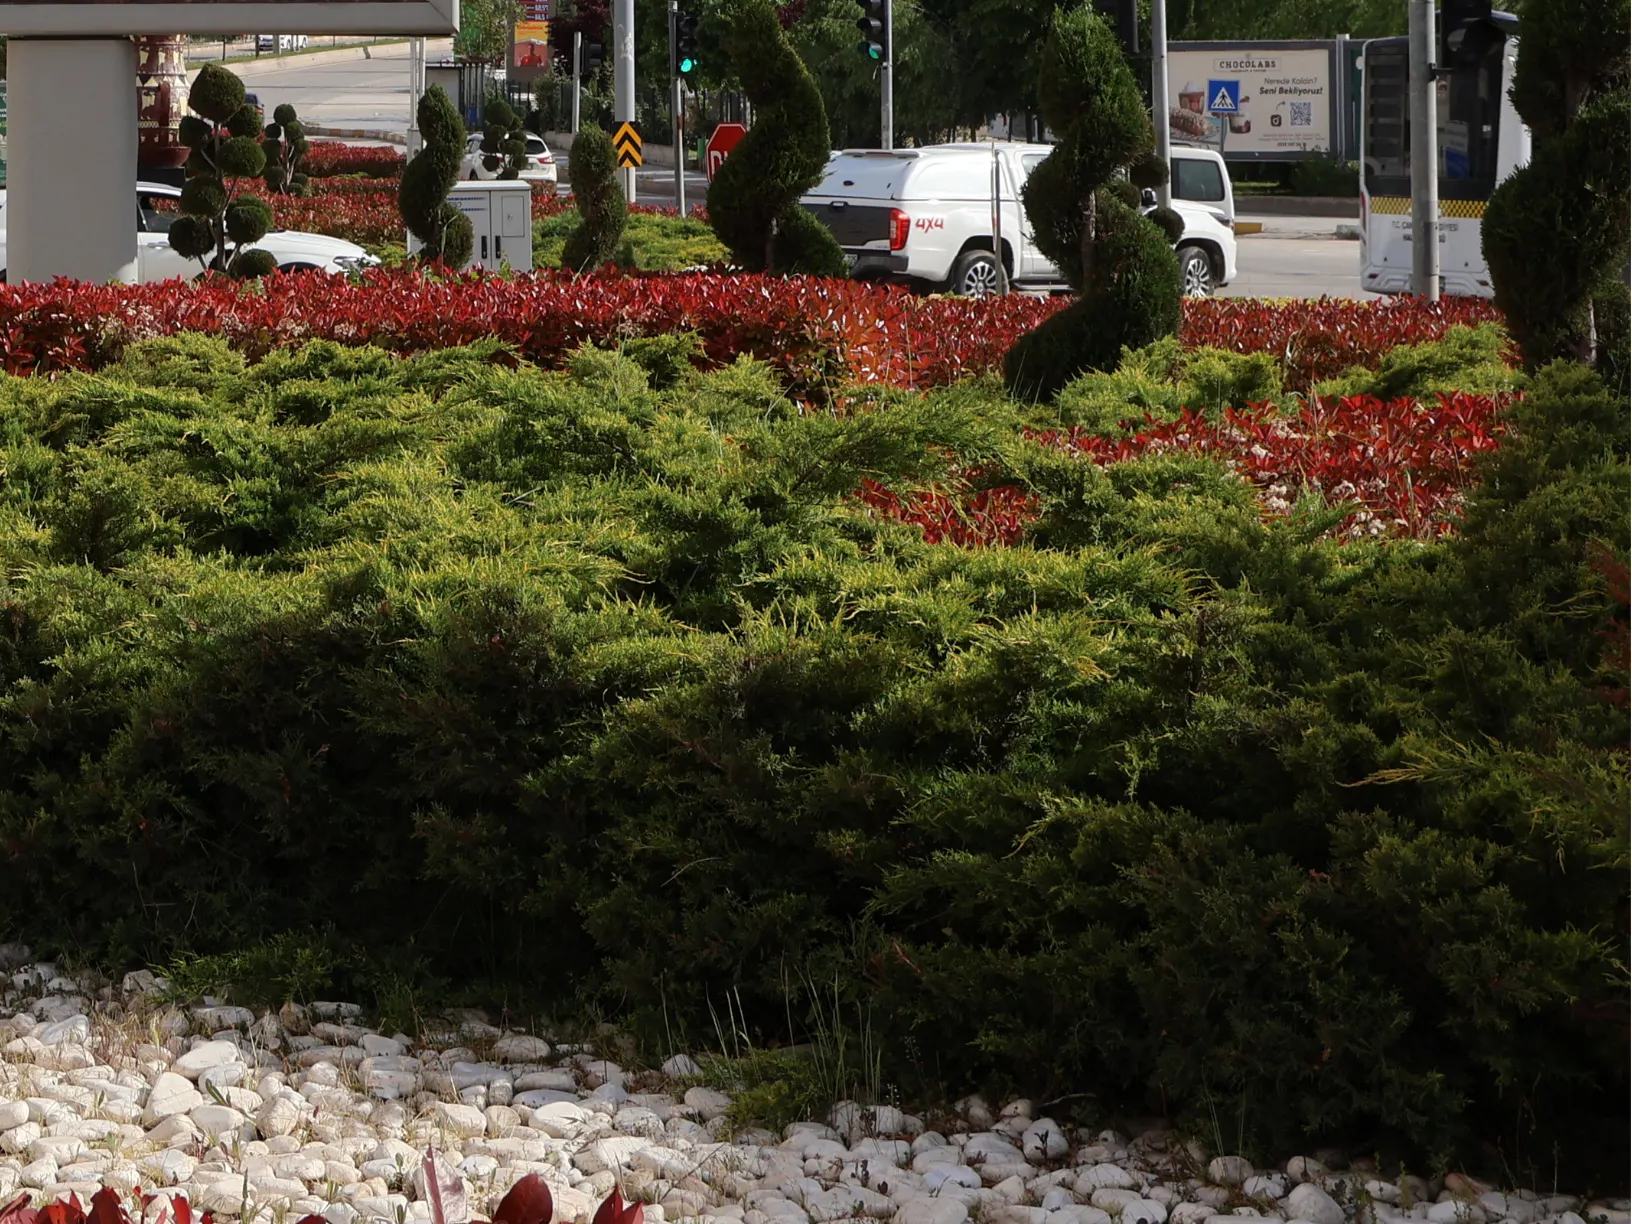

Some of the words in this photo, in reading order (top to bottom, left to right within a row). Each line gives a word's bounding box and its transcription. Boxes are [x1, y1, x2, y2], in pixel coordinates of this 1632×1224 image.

[1219, 60, 1276, 69] CHOCOLABS
[1259, 86, 1277, 95] Seni
[1278, 86, 1324, 96] Bekliyoruz!
